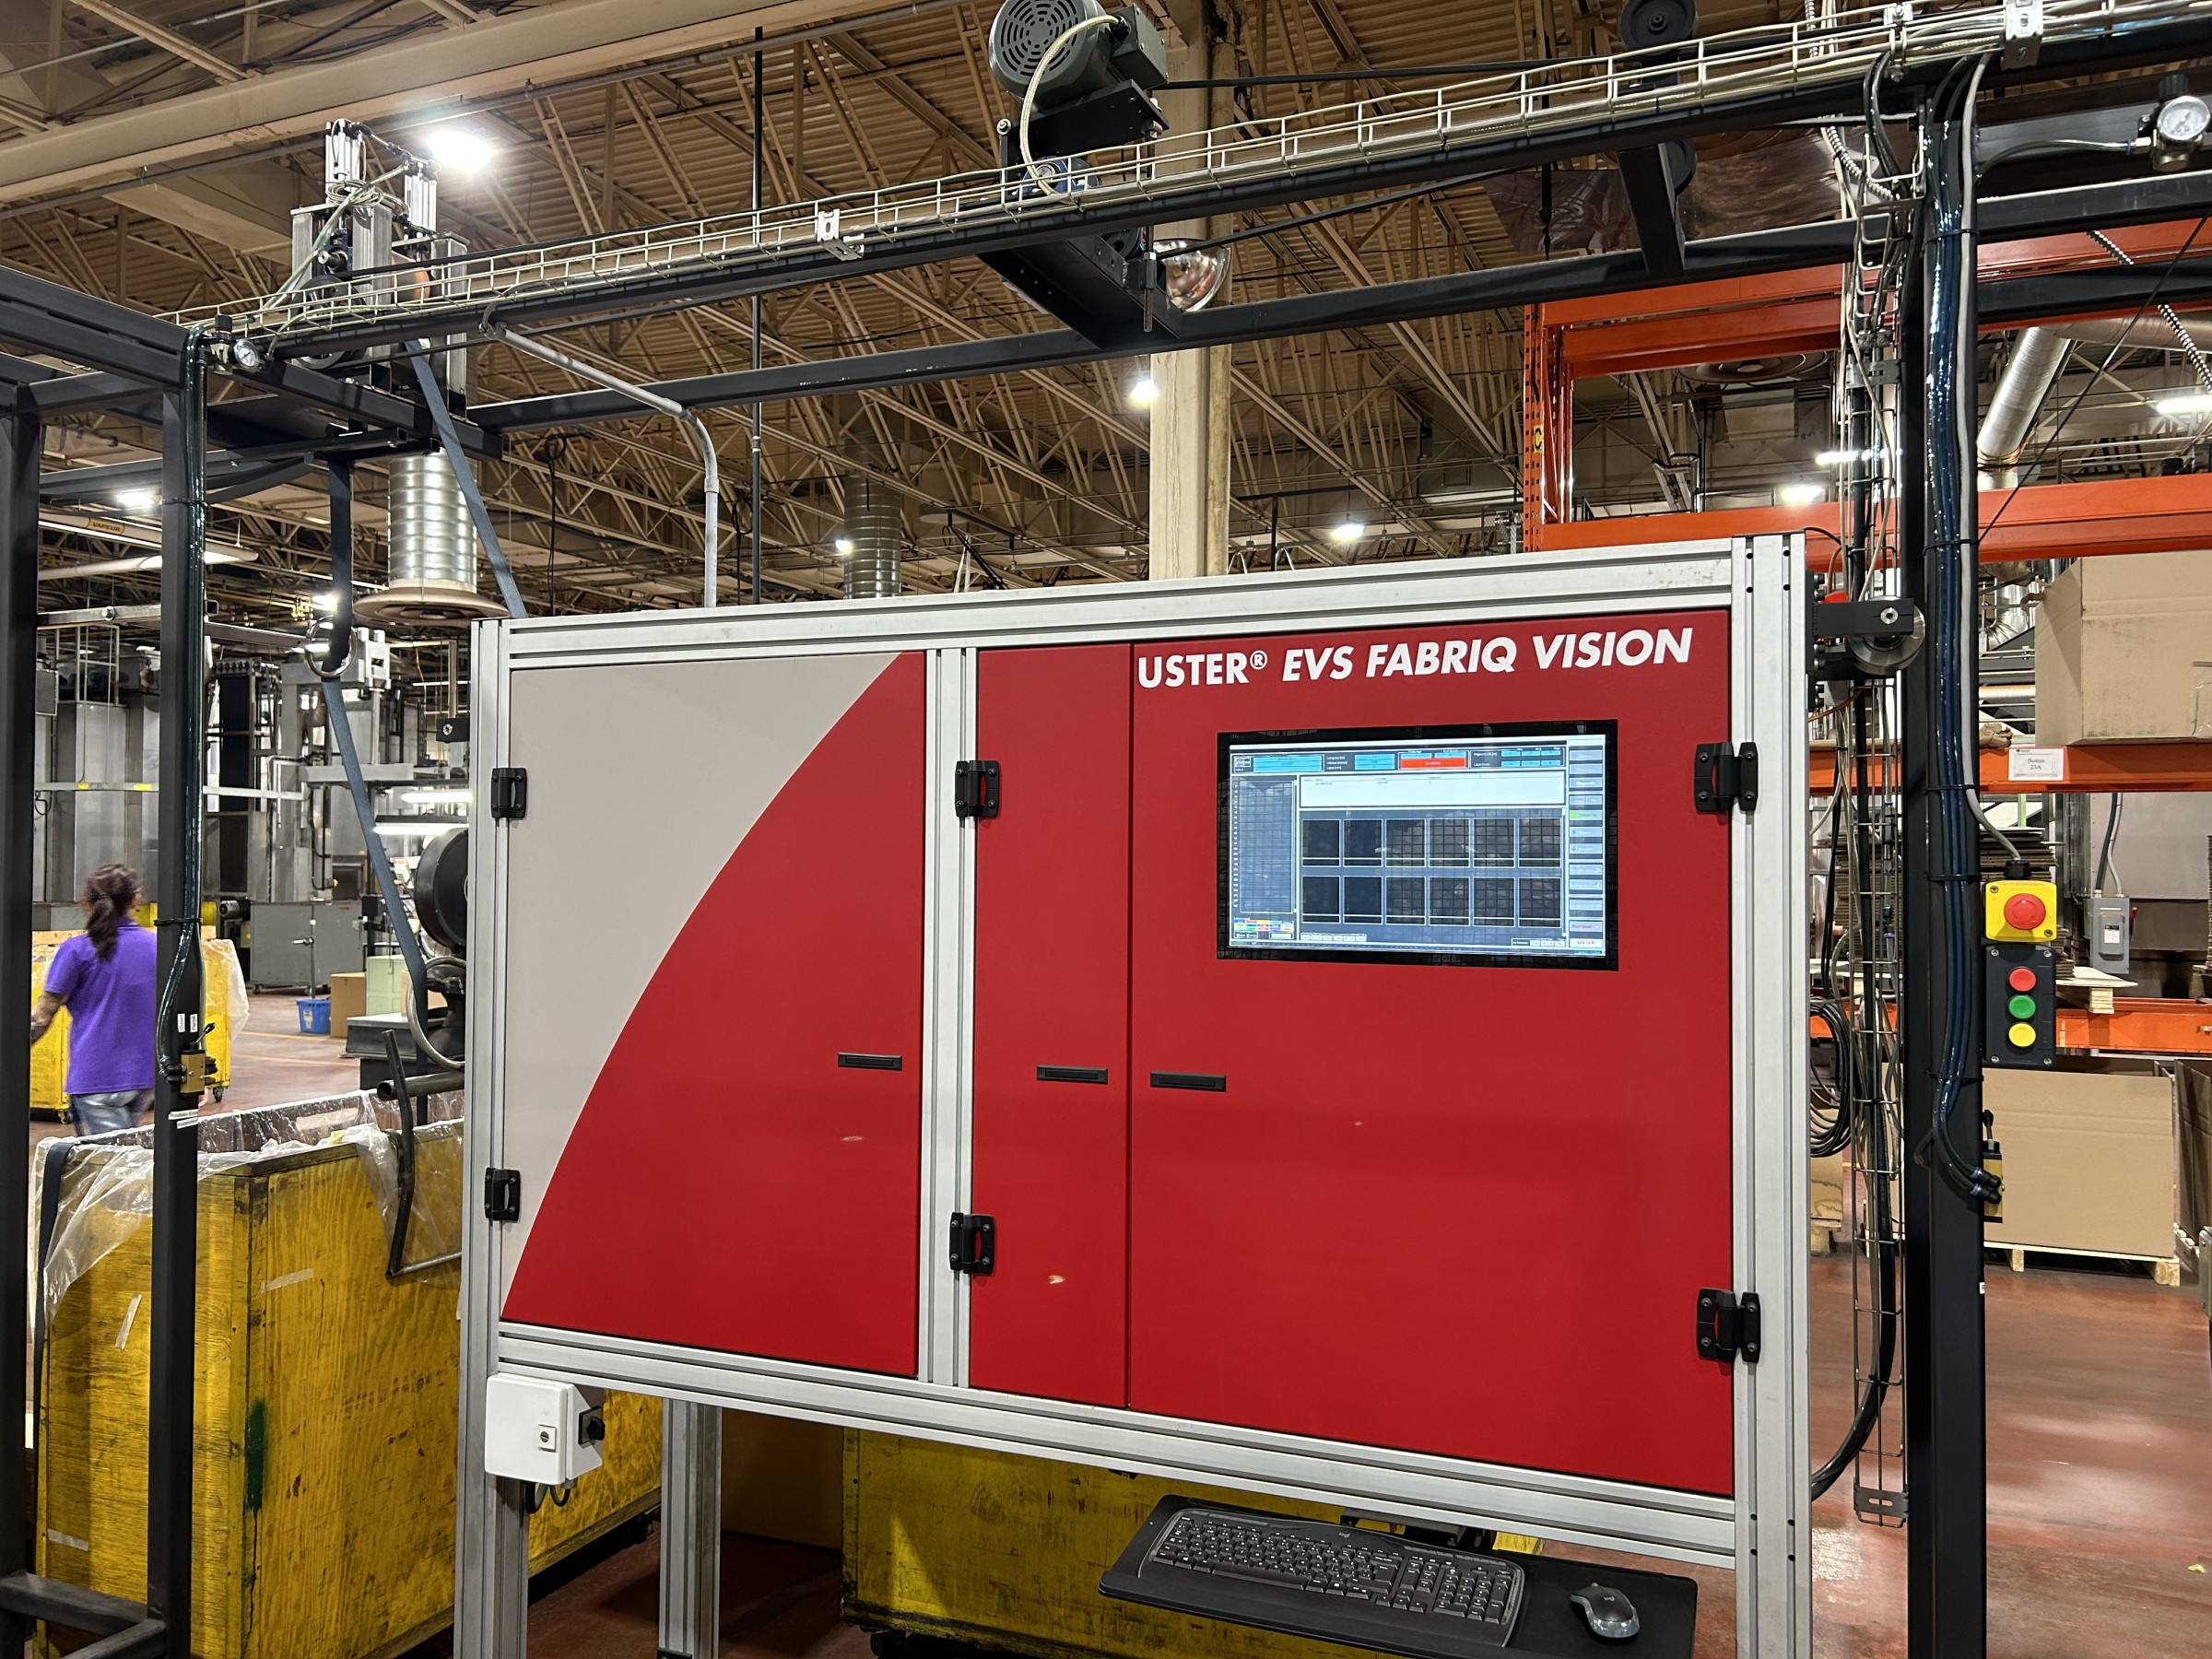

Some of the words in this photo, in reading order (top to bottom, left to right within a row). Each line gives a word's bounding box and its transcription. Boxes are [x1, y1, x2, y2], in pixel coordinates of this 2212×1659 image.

[1535, 428, 1542, 450] C
[92, 522, 121, 532] VAPEUR
[1137, 650, 1268, 688] USTER®
[1282, 646, 1355, 681] EVS
[1366, 636, 1517, 678] FABRIQ
[1532, 627, 1693, 670] VISION
